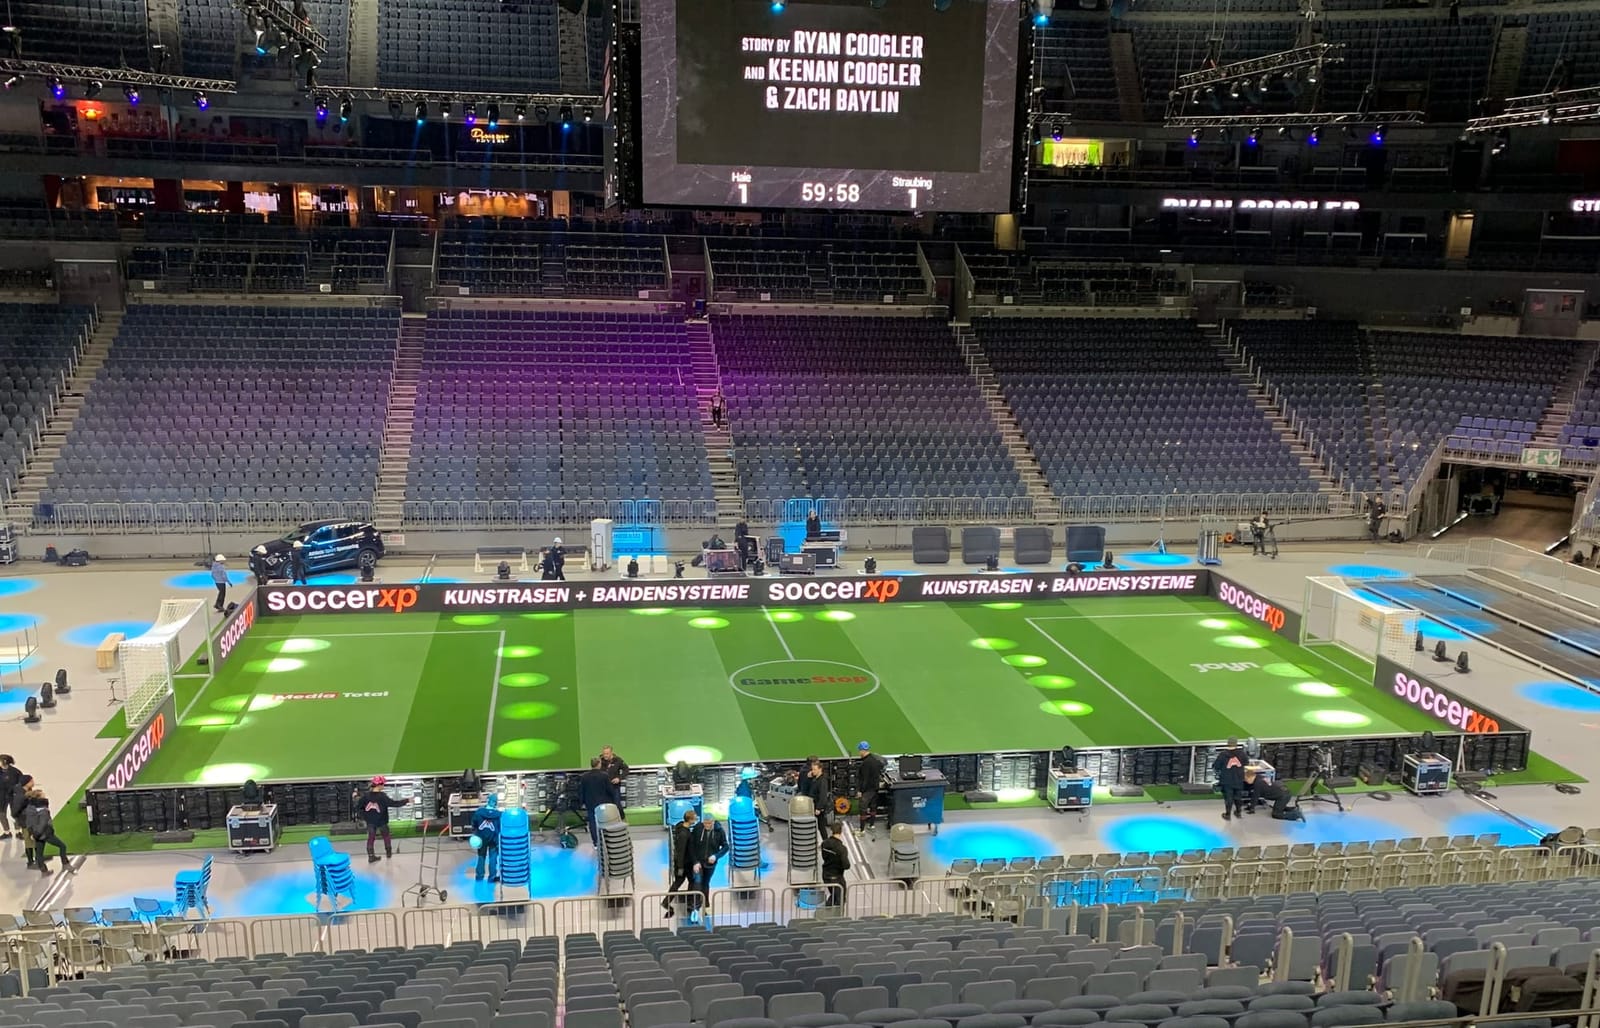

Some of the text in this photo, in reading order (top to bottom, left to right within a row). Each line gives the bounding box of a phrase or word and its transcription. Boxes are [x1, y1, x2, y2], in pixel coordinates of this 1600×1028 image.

[741, 31, 923, 58] STORY BY RYAN COOGLER
[744, 58, 921, 86] AND KEENAN COOGLER
[766, 86, 899, 113] & ZACH BAYLIN
[737, 184, 748, 204] 1
[801, 182, 860, 203] 59:58
[892, 176, 933, 191] Straubing
[907, 188, 918, 209] 1
[267, 574, 1197, 613] soccerxp KUNSTRASEN + BANDENSYSTEME soccerxp KUNSTRASEN + BANDENSYSTEME
[1220, 581, 1285, 632] soccerxp
[220, 600, 254, 658] soccerxp
[741, 675, 868, 686] GameStop
